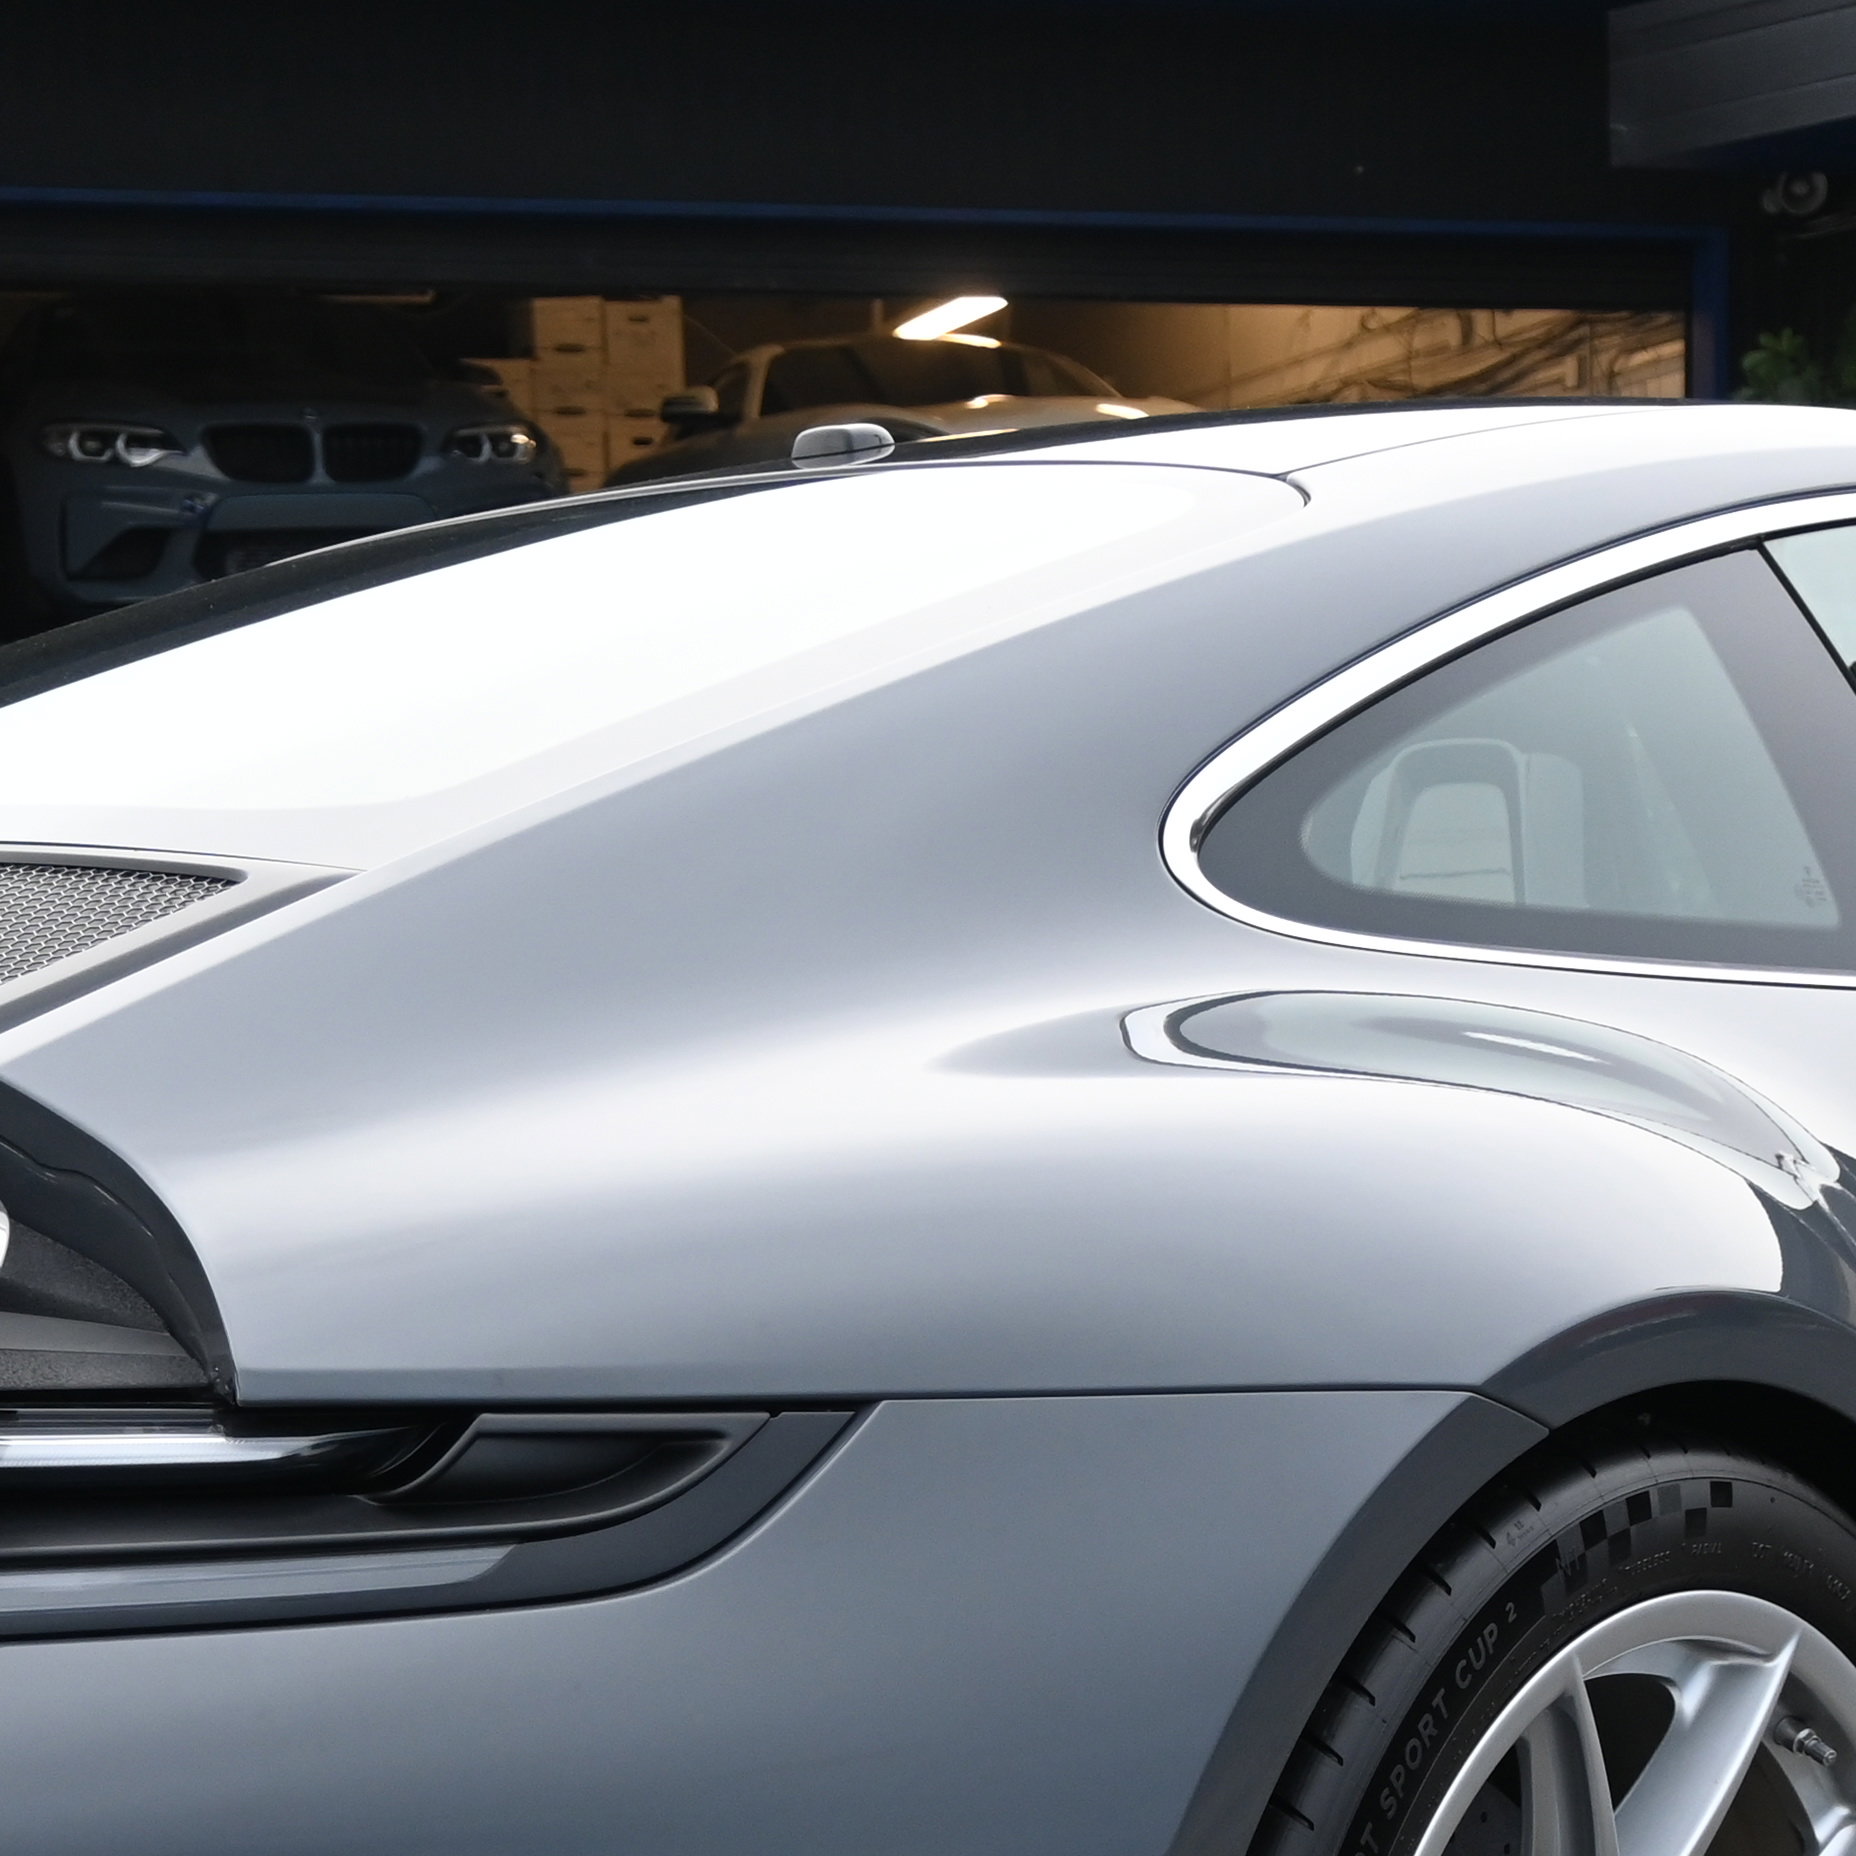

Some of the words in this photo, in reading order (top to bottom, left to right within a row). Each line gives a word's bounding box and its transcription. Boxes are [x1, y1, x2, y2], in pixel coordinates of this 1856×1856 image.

[1380, 1688, 1450, 1820] SPORT
[1455, 1622, 1498, 1689] CUP
[1505, 1602, 1518, 1624] 2
